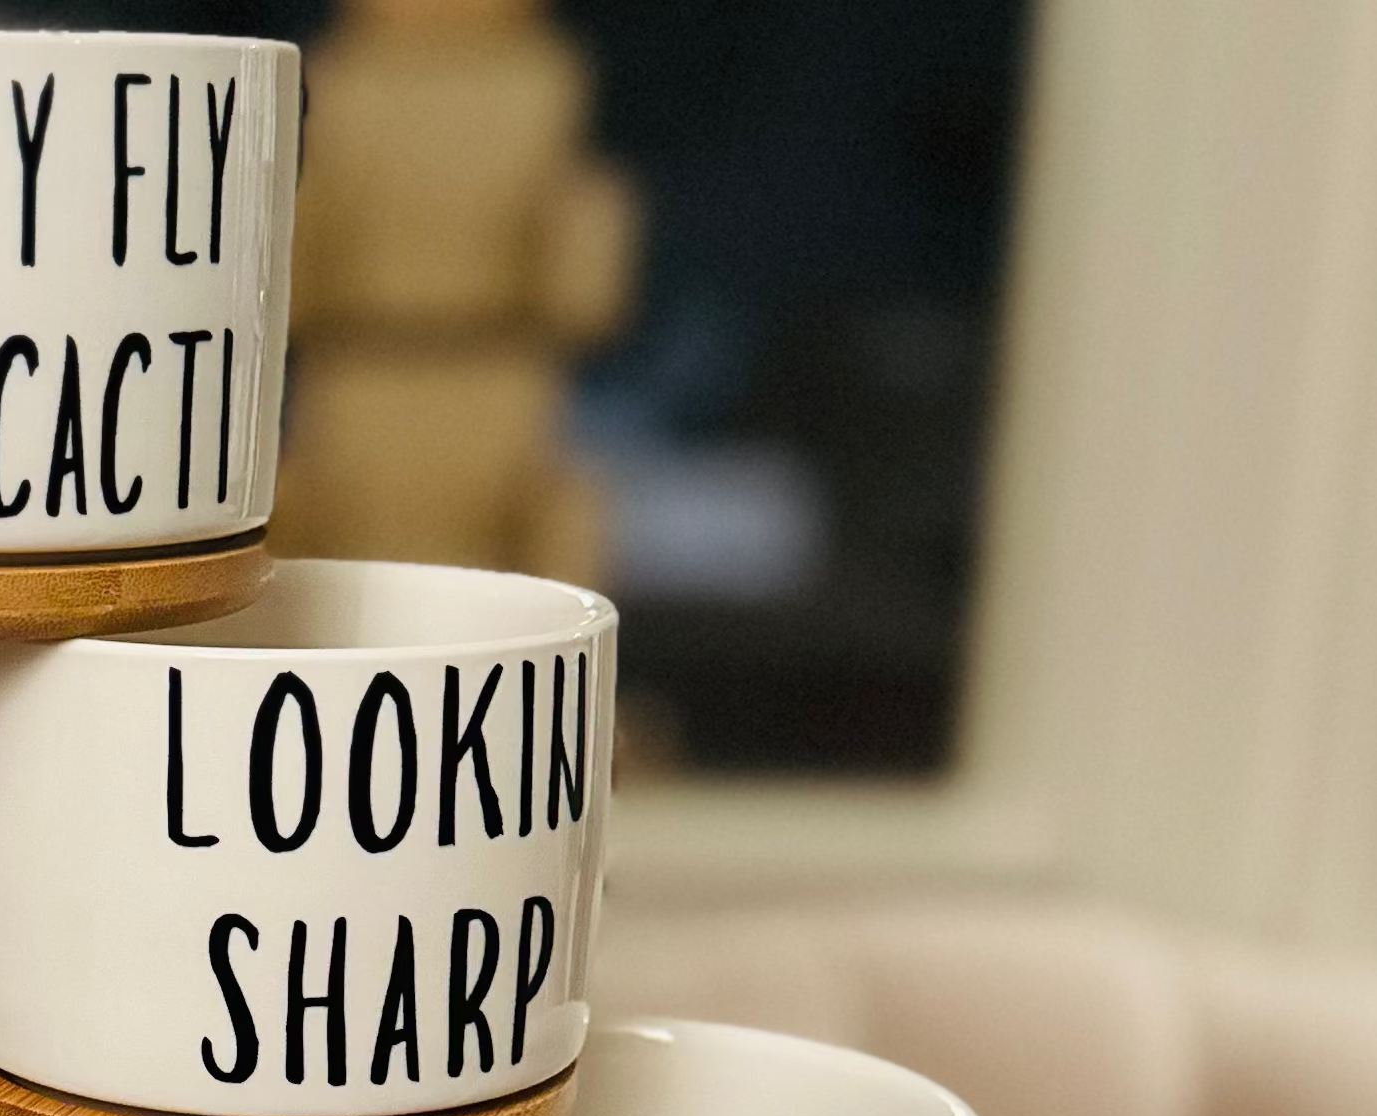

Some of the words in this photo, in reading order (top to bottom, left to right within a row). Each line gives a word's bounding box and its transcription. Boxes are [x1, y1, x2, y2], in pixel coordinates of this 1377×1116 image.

[112, 73, 236, 267] FLY
[166, 651, 588, 854] LOOKIN
[201, 895, 555, 1086] SHARP
